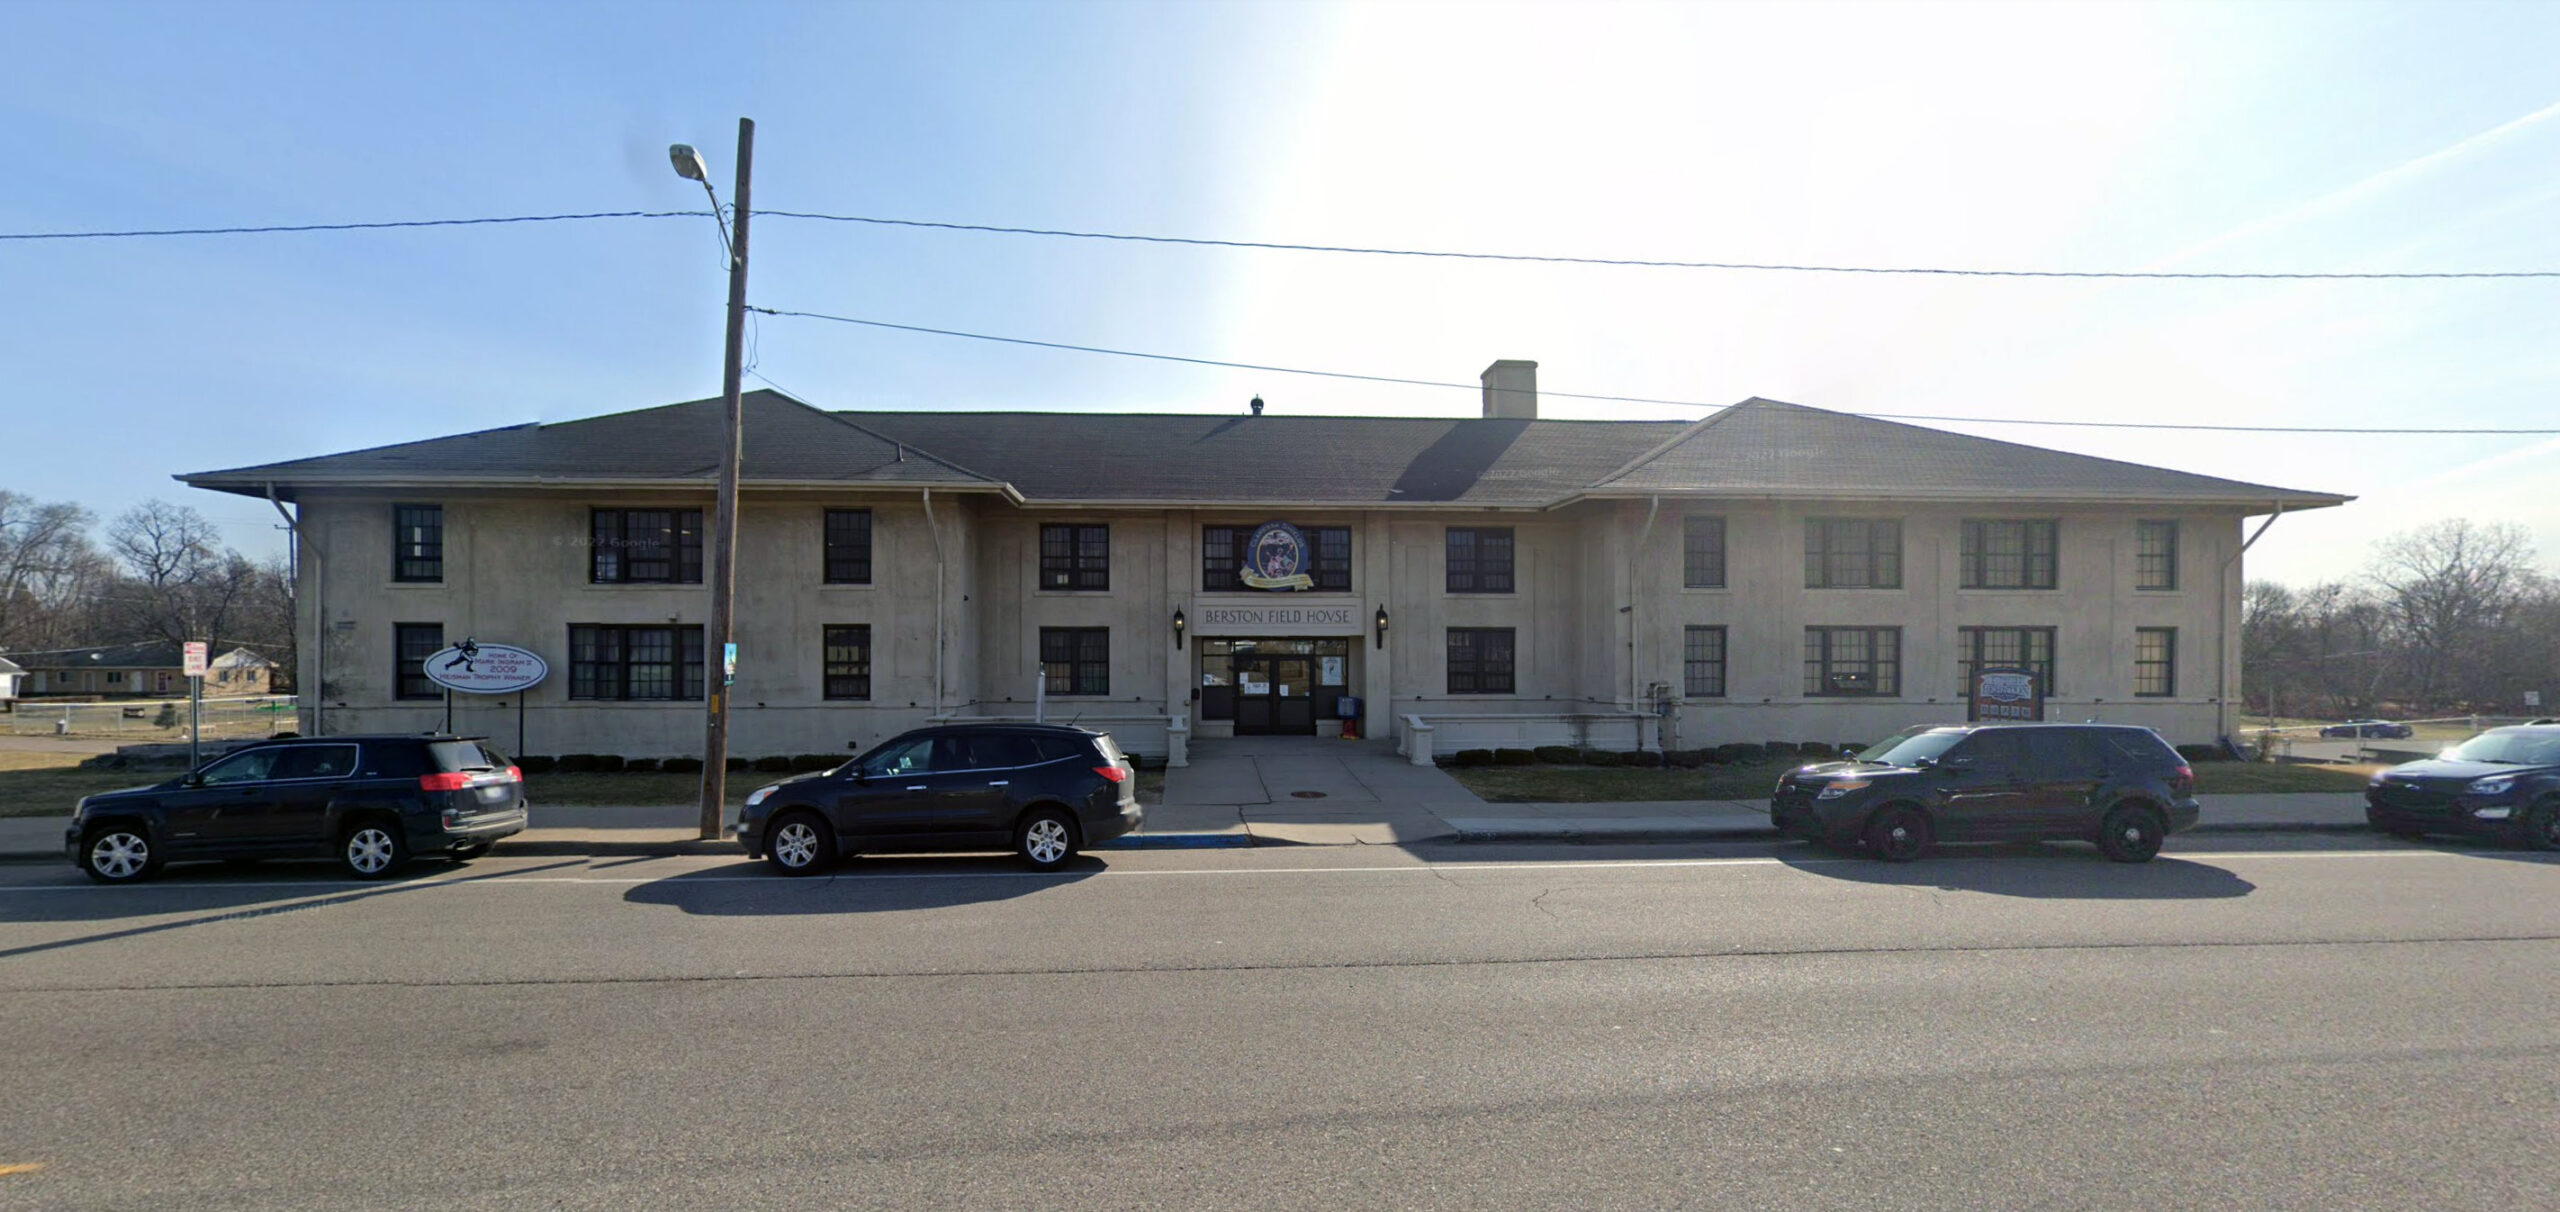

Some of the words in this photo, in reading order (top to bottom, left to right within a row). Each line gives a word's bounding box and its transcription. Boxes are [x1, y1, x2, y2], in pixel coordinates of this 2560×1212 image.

[1205, 610, 1263, 624] BERSTON
[1268, 610, 1301, 624] FIELD
[489, 665, 518, 673] 2009
